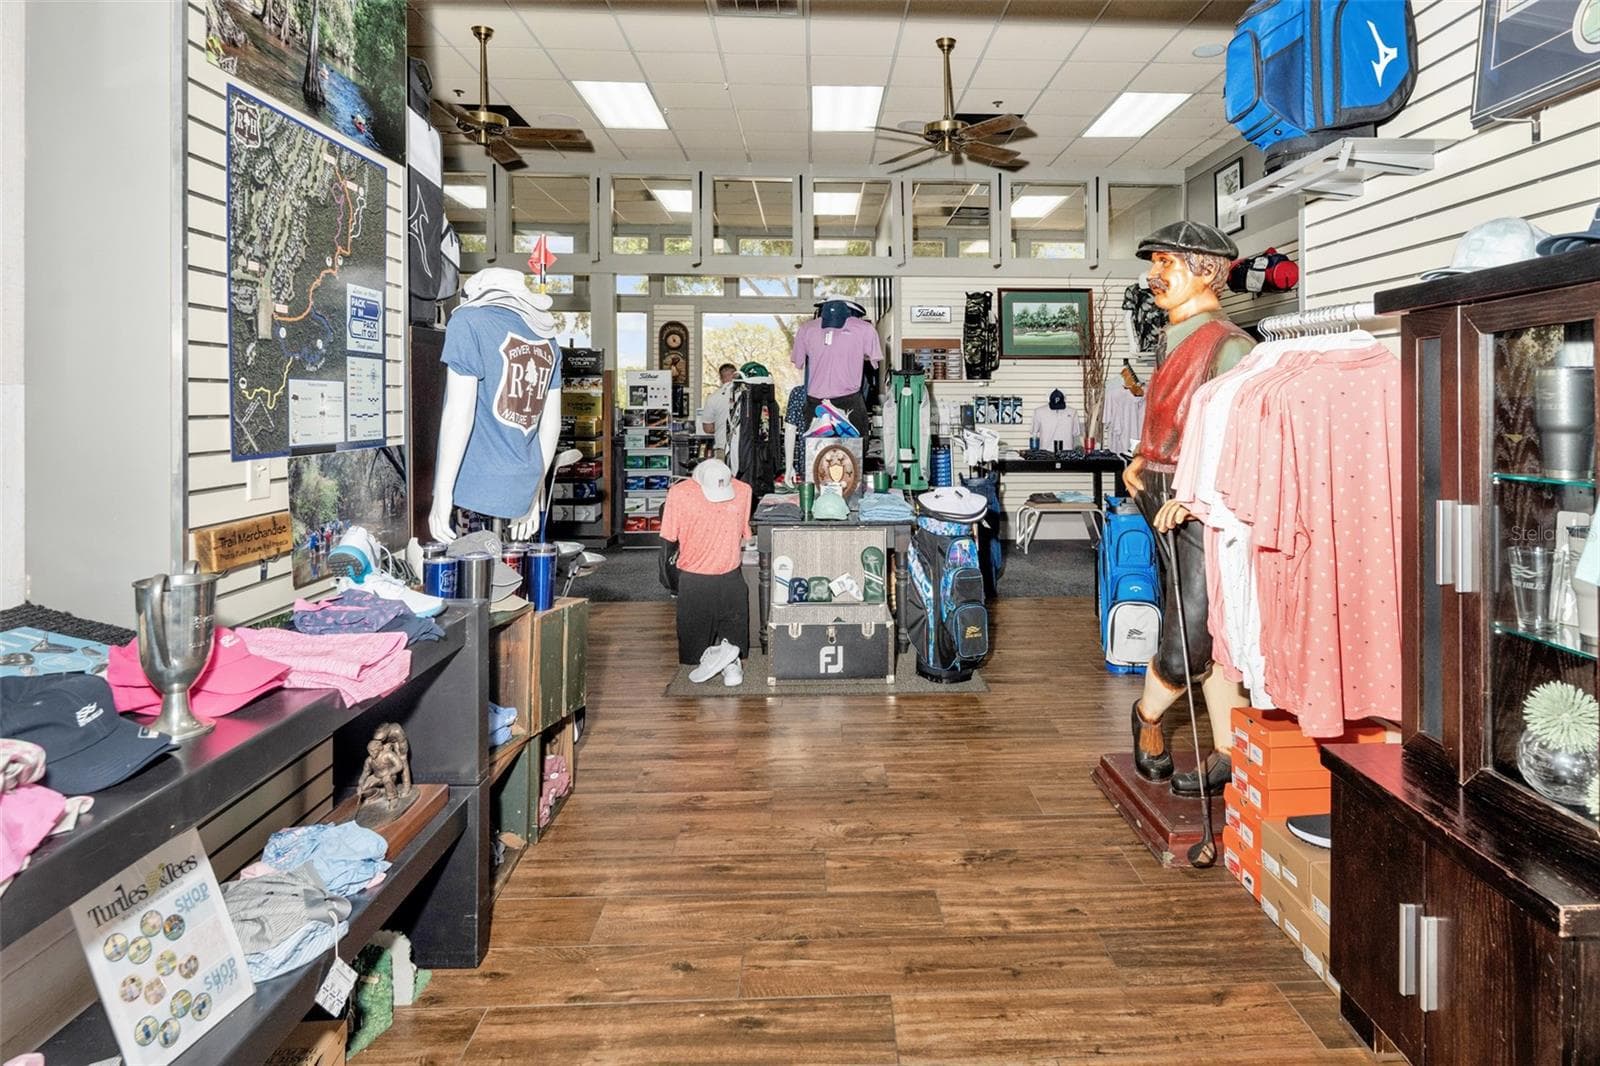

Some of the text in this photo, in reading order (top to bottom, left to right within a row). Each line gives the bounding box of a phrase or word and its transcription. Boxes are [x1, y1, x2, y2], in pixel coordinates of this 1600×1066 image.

[351, 297, 366, 308] PACK
[361, 329, 377, 338] IT OUT
[363, 321, 377, 329] PACK
[509, 345, 552, 366] RIVER HILLS
[508, 363, 550, 400] R H
[218, 516, 287, 548] Trail Merchandise
[820, 646, 843, 673] FJ
[87, 883, 149, 928] Turtles
[175, 882, 209, 912] SHOP
[204, 957, 237, 991] SHOP
